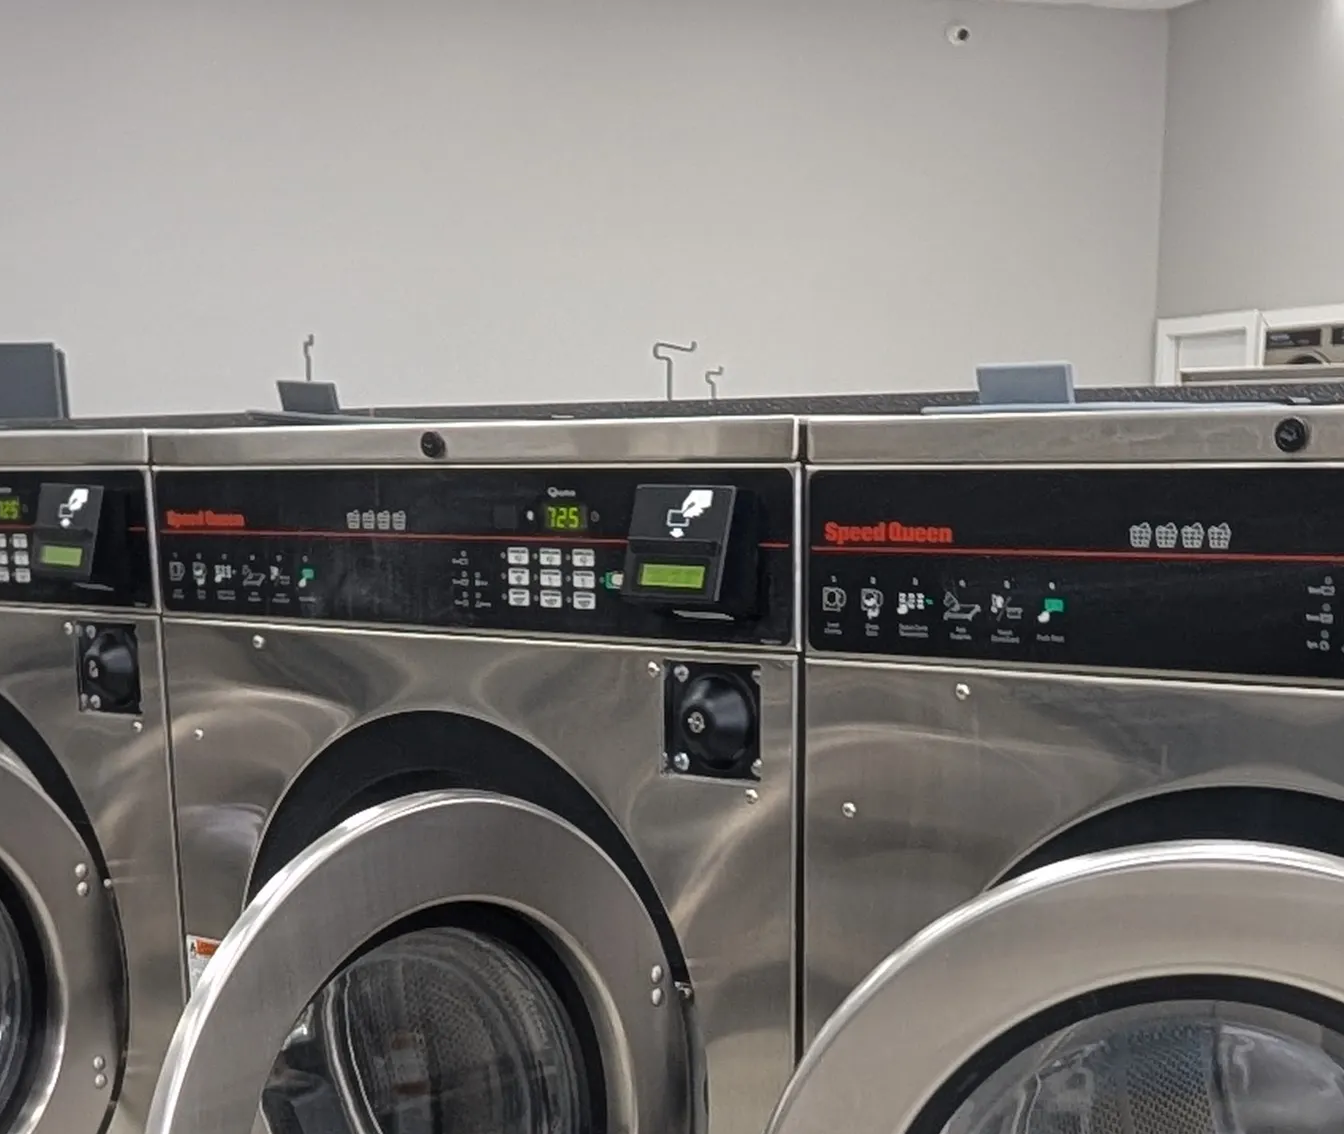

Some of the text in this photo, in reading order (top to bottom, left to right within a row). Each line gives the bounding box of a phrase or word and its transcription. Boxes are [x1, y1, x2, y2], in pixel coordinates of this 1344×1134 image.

[547, 506, 580, 529] 725
[824, 519, 953, 546] Speed Queen
